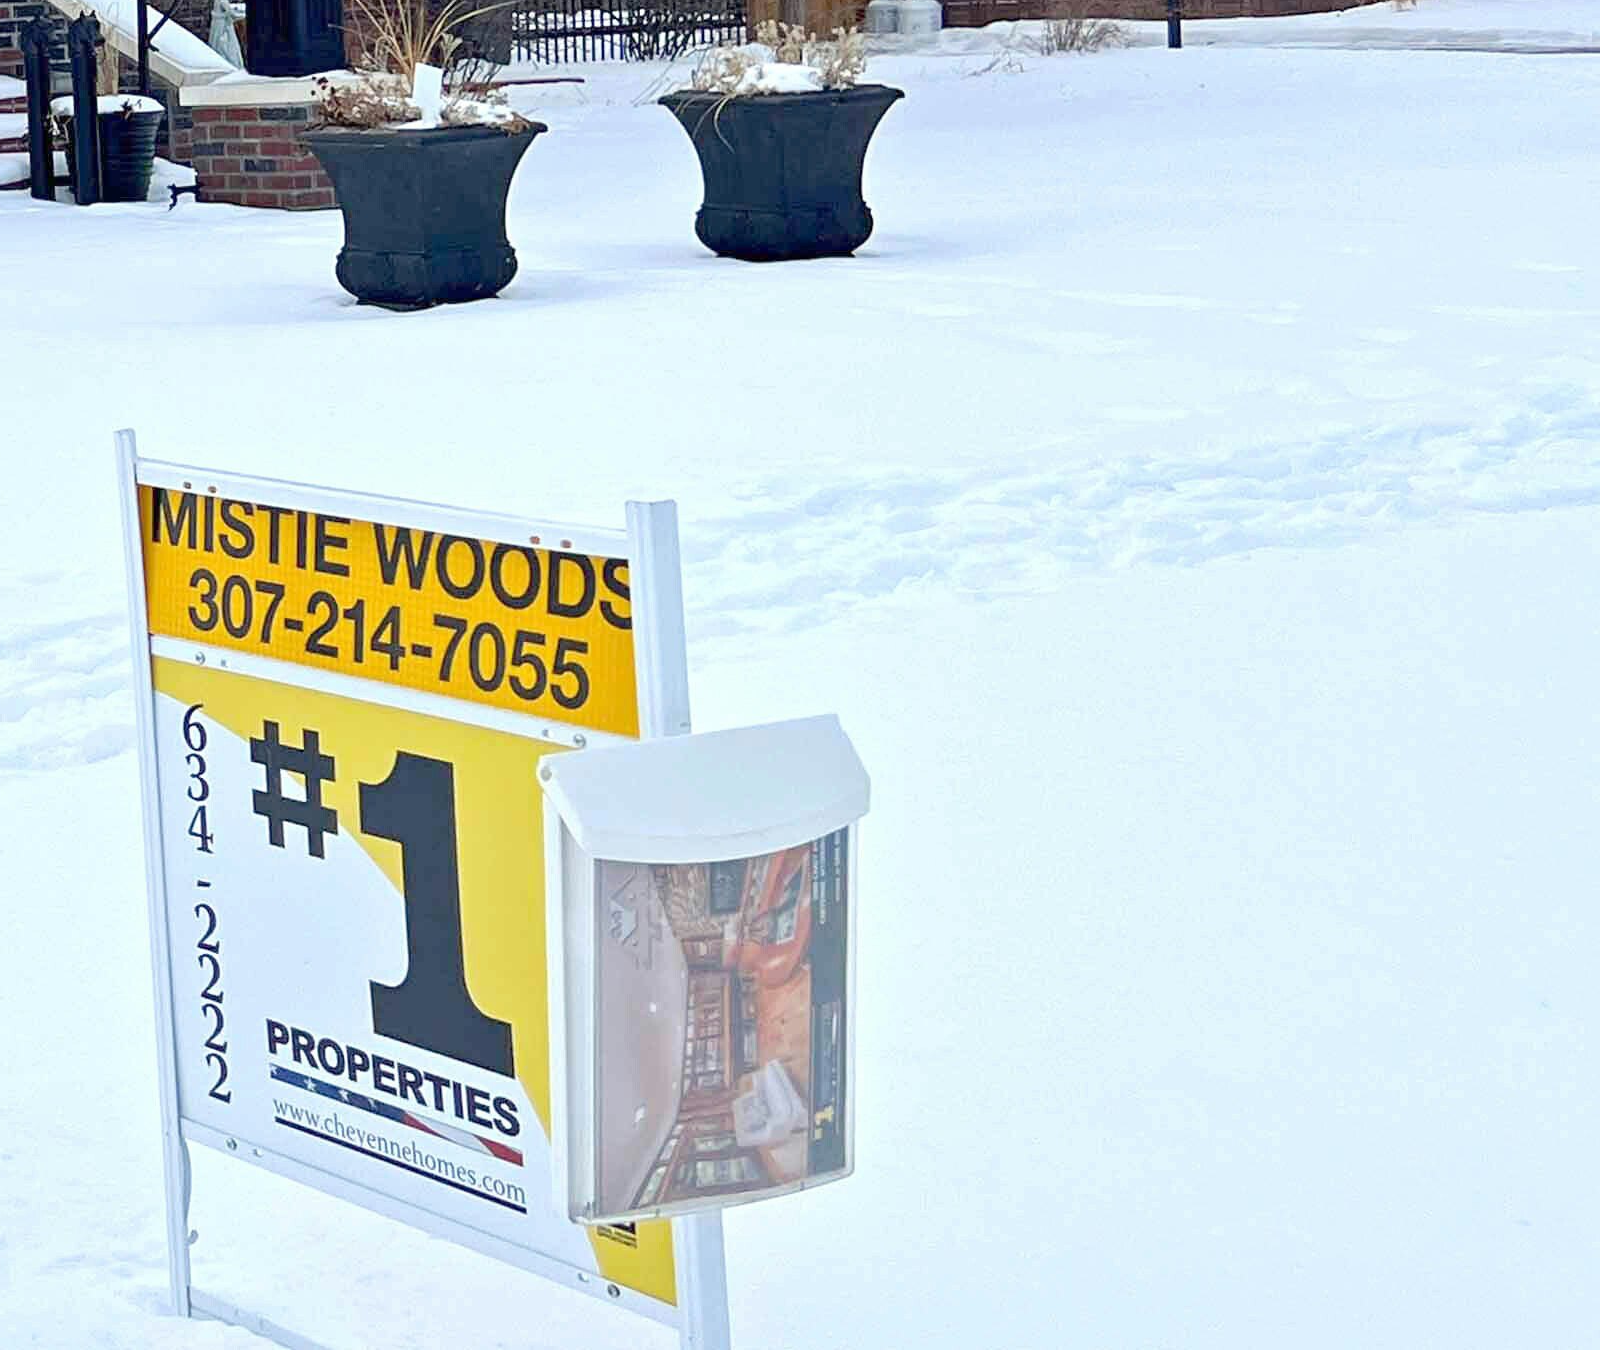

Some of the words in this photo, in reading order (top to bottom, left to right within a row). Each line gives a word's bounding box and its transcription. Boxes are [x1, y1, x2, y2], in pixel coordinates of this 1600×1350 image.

[151, 486, 351, 577] MISTIE
[373, 523, 633, 630] WOODS
[188, 568, 590, 710] 307-214-7055
[250, 719, 516, 1080] #1
[266, 1018, 521, 1137] PROPERTIES
[273, 1098, 527, 1205] www.cheyennehomes.com
